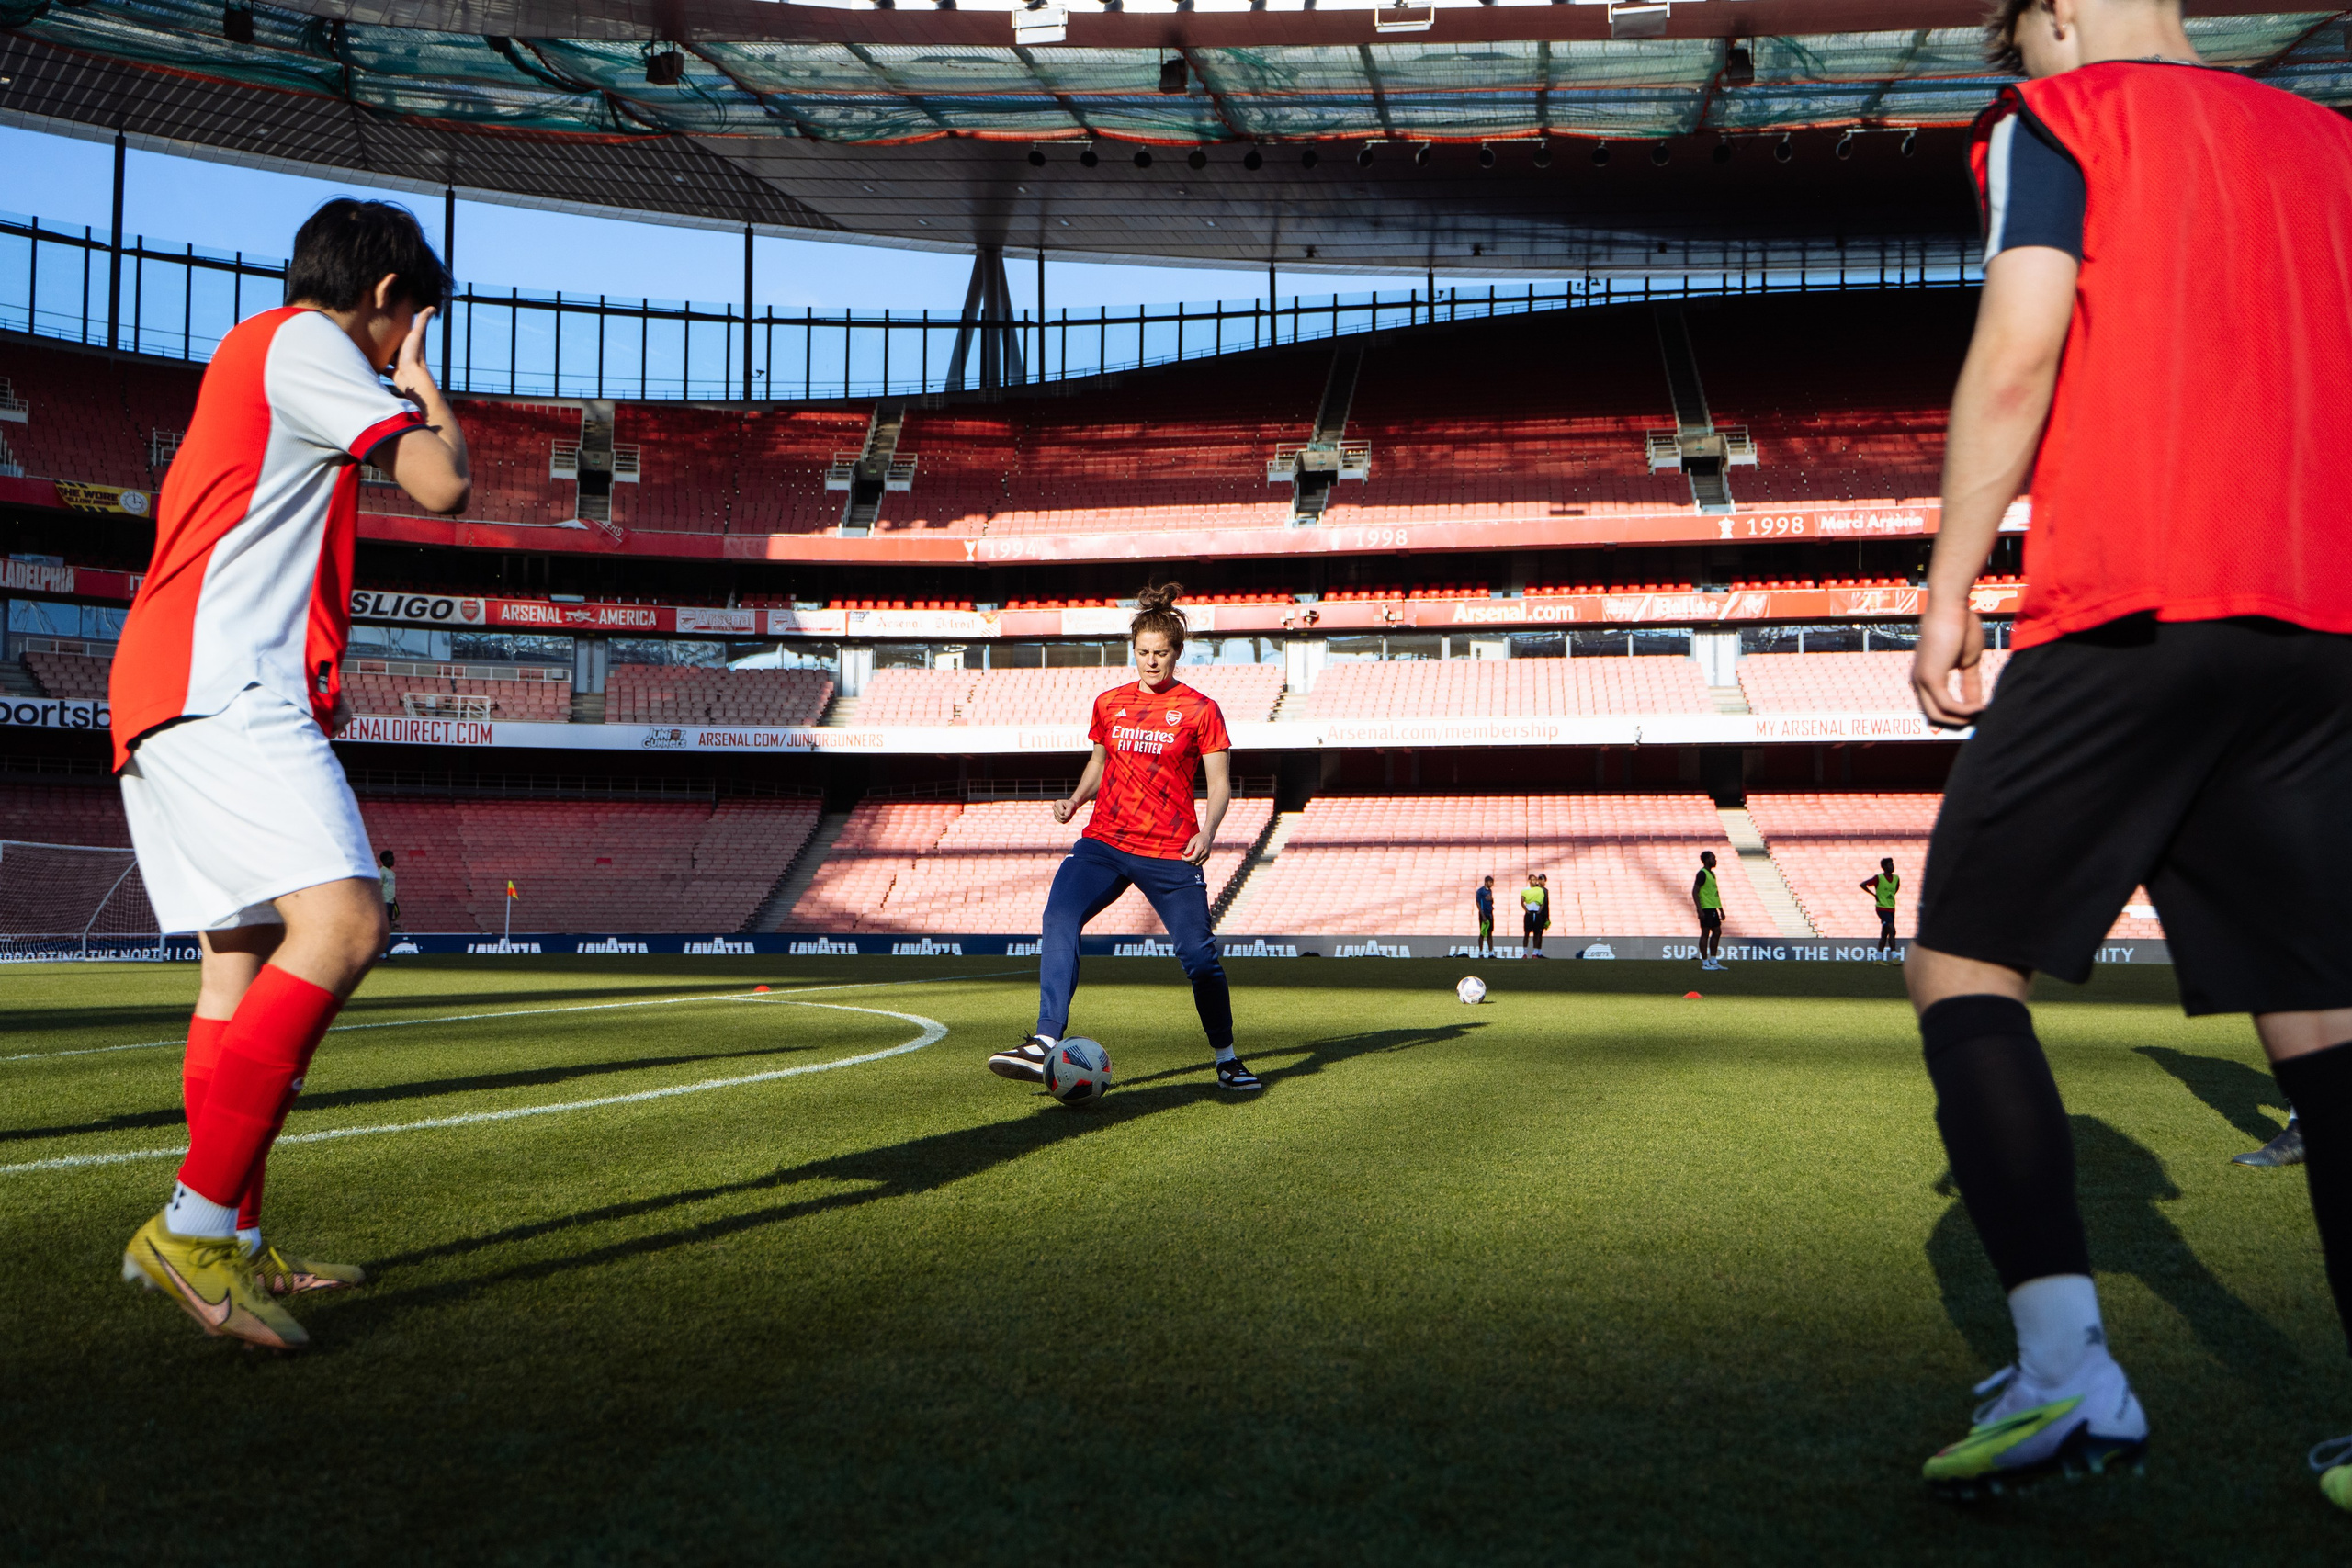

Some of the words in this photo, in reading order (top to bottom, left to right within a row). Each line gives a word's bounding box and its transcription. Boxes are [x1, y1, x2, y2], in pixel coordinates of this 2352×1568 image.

[1747, 515, 1804, 536] 1998
[1820, 515, 1864, 531] Merci
[1354, 528, 1408, 547] 1998
[987, 540, 1037, 558] 1994
[351, 592, 455, 620] SLIGO
[501, 604, 563, 625] ARSENAL
[598, 608, 658, 626] AMERICA
[1452, 603, 1575, 623] Arsenal.com
[695, 608, 754, 626] Arsenal
[1112, 725, 1175, 744] Emirates
[1327, 721, 1559, 742] Arsenal.com/membership
[1756, 720, 1776, 737] MY
[1781, 719, 1846, 736] ARSENAL
[1851, 718, 1922, 736] REWARDS
[1117, 739, 1132, 752] FLY
[1133, 741, 1163, 755] BETTER
[1114, 938, 1176, 956] LAVAZZ
[1662, 945, 1786, 961] SUPORTING
[1792, 946, 1829, 961] THE
[1836, 946, 1905, 962] NORTH
